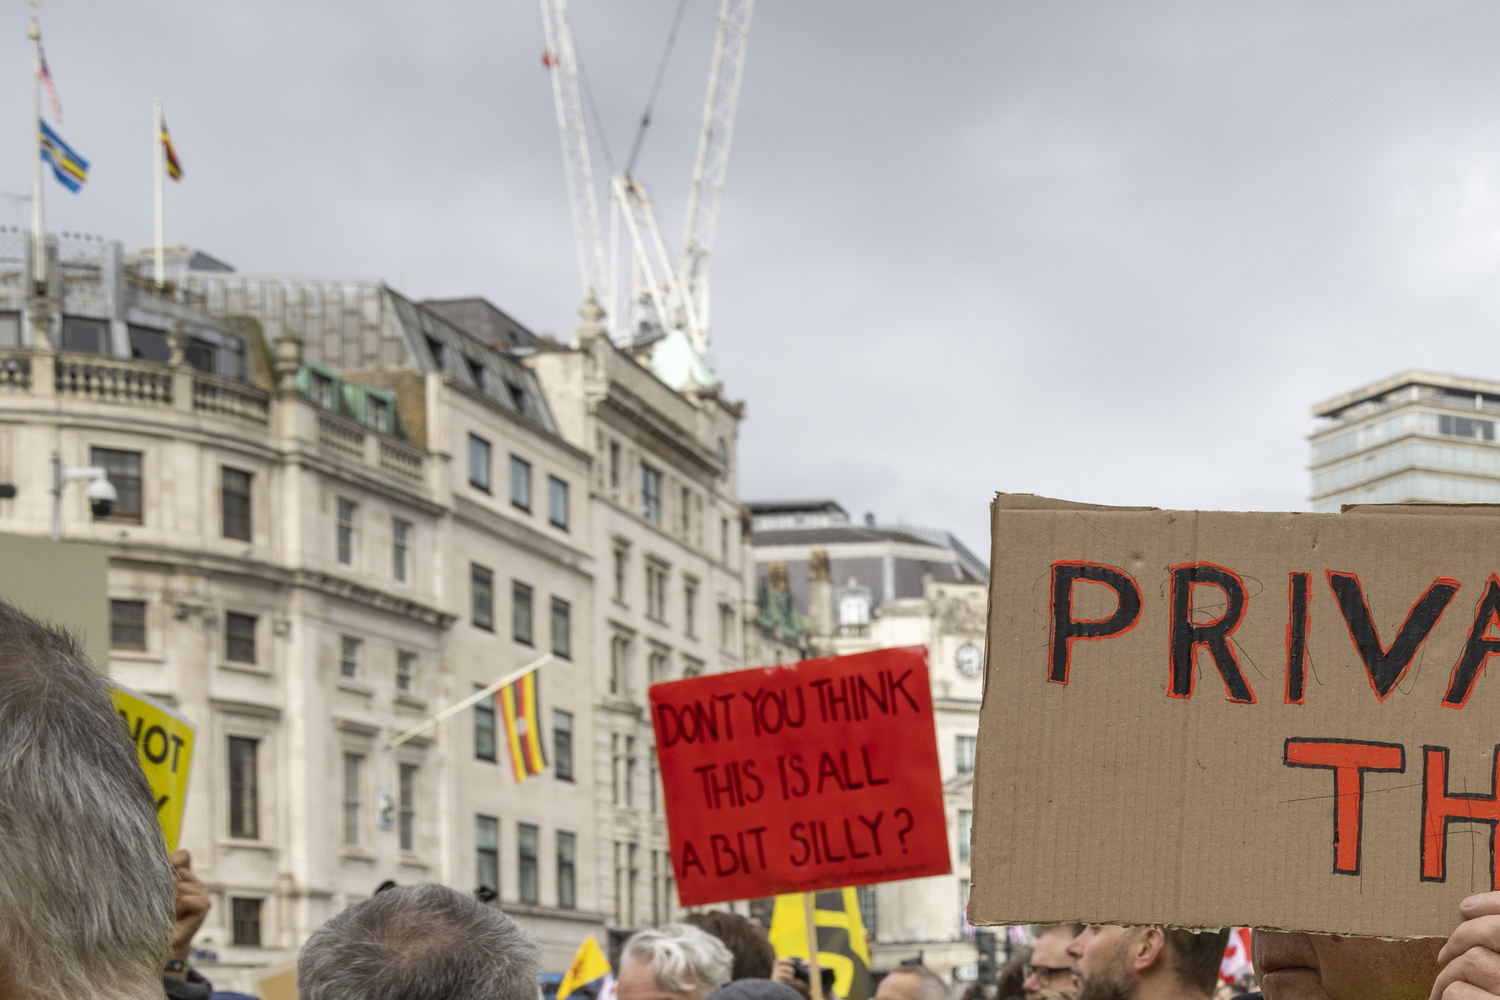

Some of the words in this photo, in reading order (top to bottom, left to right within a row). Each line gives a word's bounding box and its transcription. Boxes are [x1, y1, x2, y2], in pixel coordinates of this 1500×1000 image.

[743, 684, 806, 736] YOU
[809, 668, 920, 723] THINK
[694, 760, 765, 810] THIS
[778, 754, 811, 801] IS
[817, 746, 890, 795] ALL
[681, 840, 707, 880] A
[710, 827, 768, 878] BIT
[789, 807, 915, 868] SILLY?
